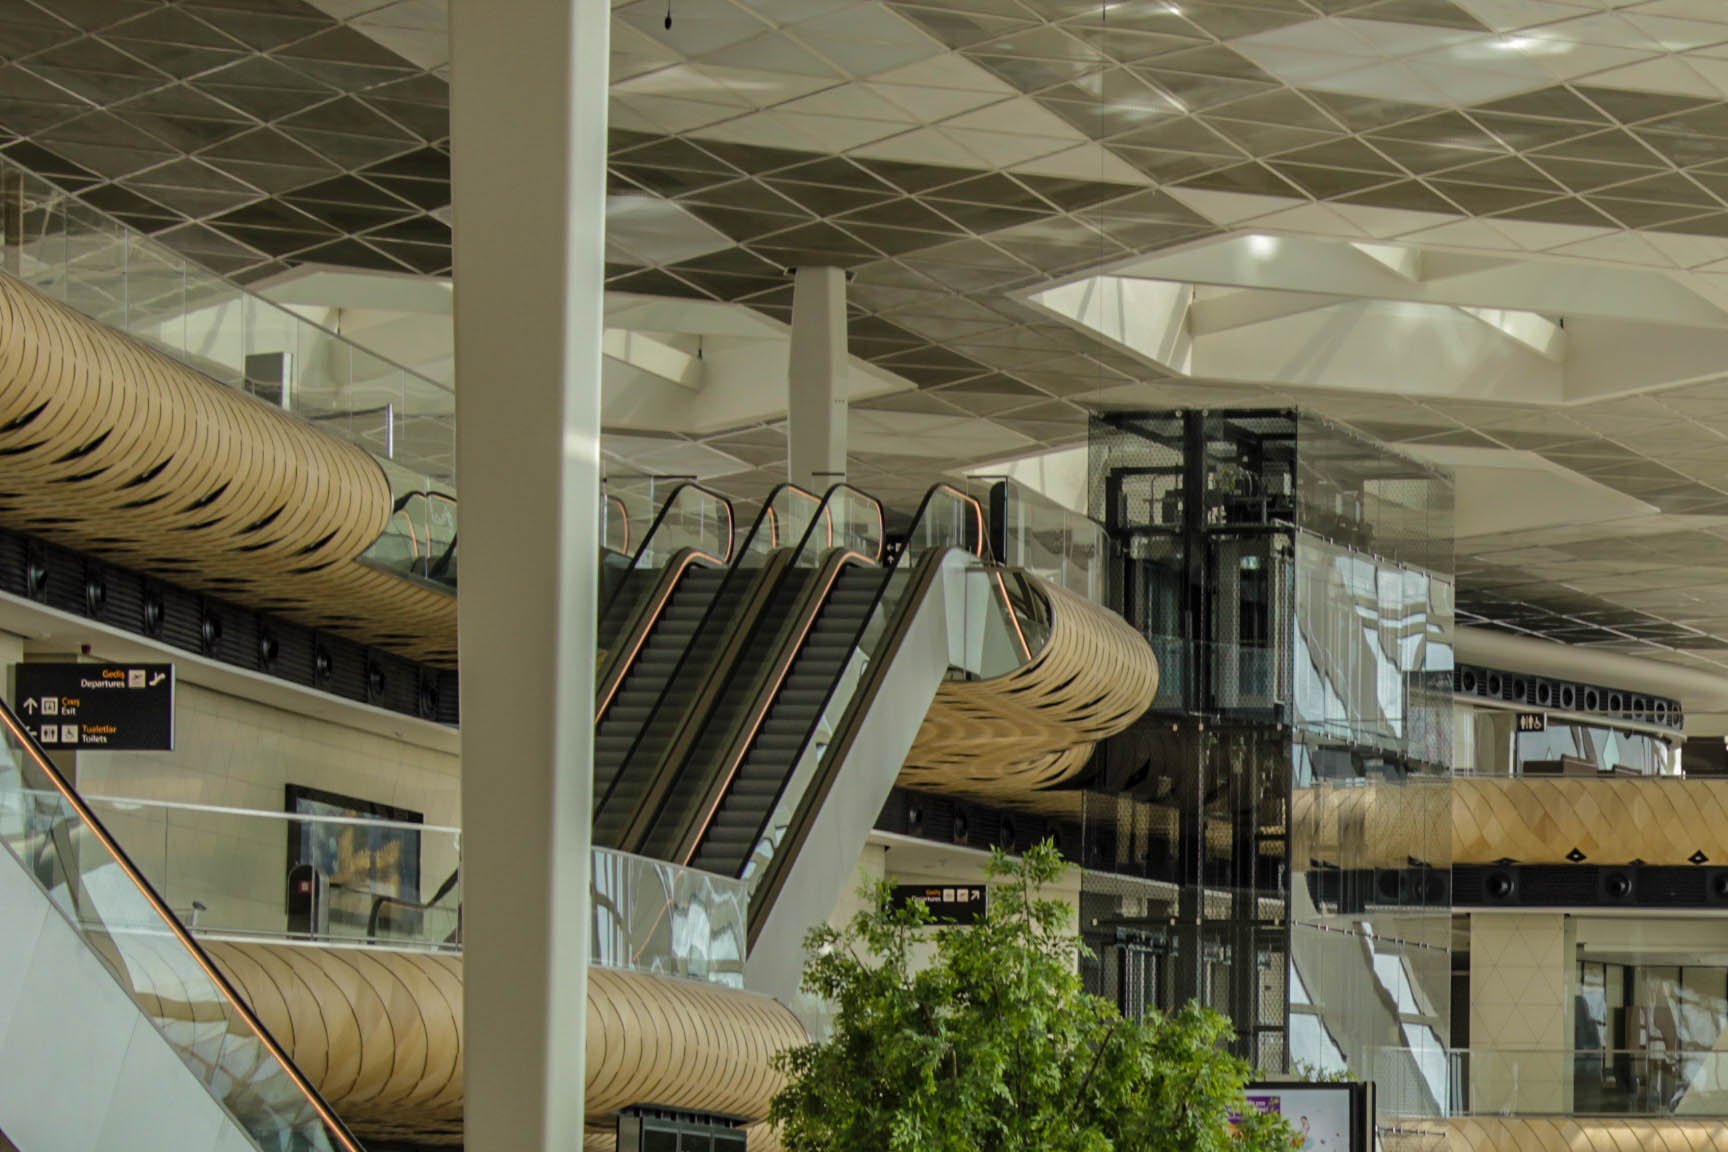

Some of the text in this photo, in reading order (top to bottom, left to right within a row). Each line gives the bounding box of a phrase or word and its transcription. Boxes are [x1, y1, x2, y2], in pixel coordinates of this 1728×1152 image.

[81, 679, 125, 688] Departures
[61, 706, 76, 715] Exit
[82, 734, 107, 743] Toilets
